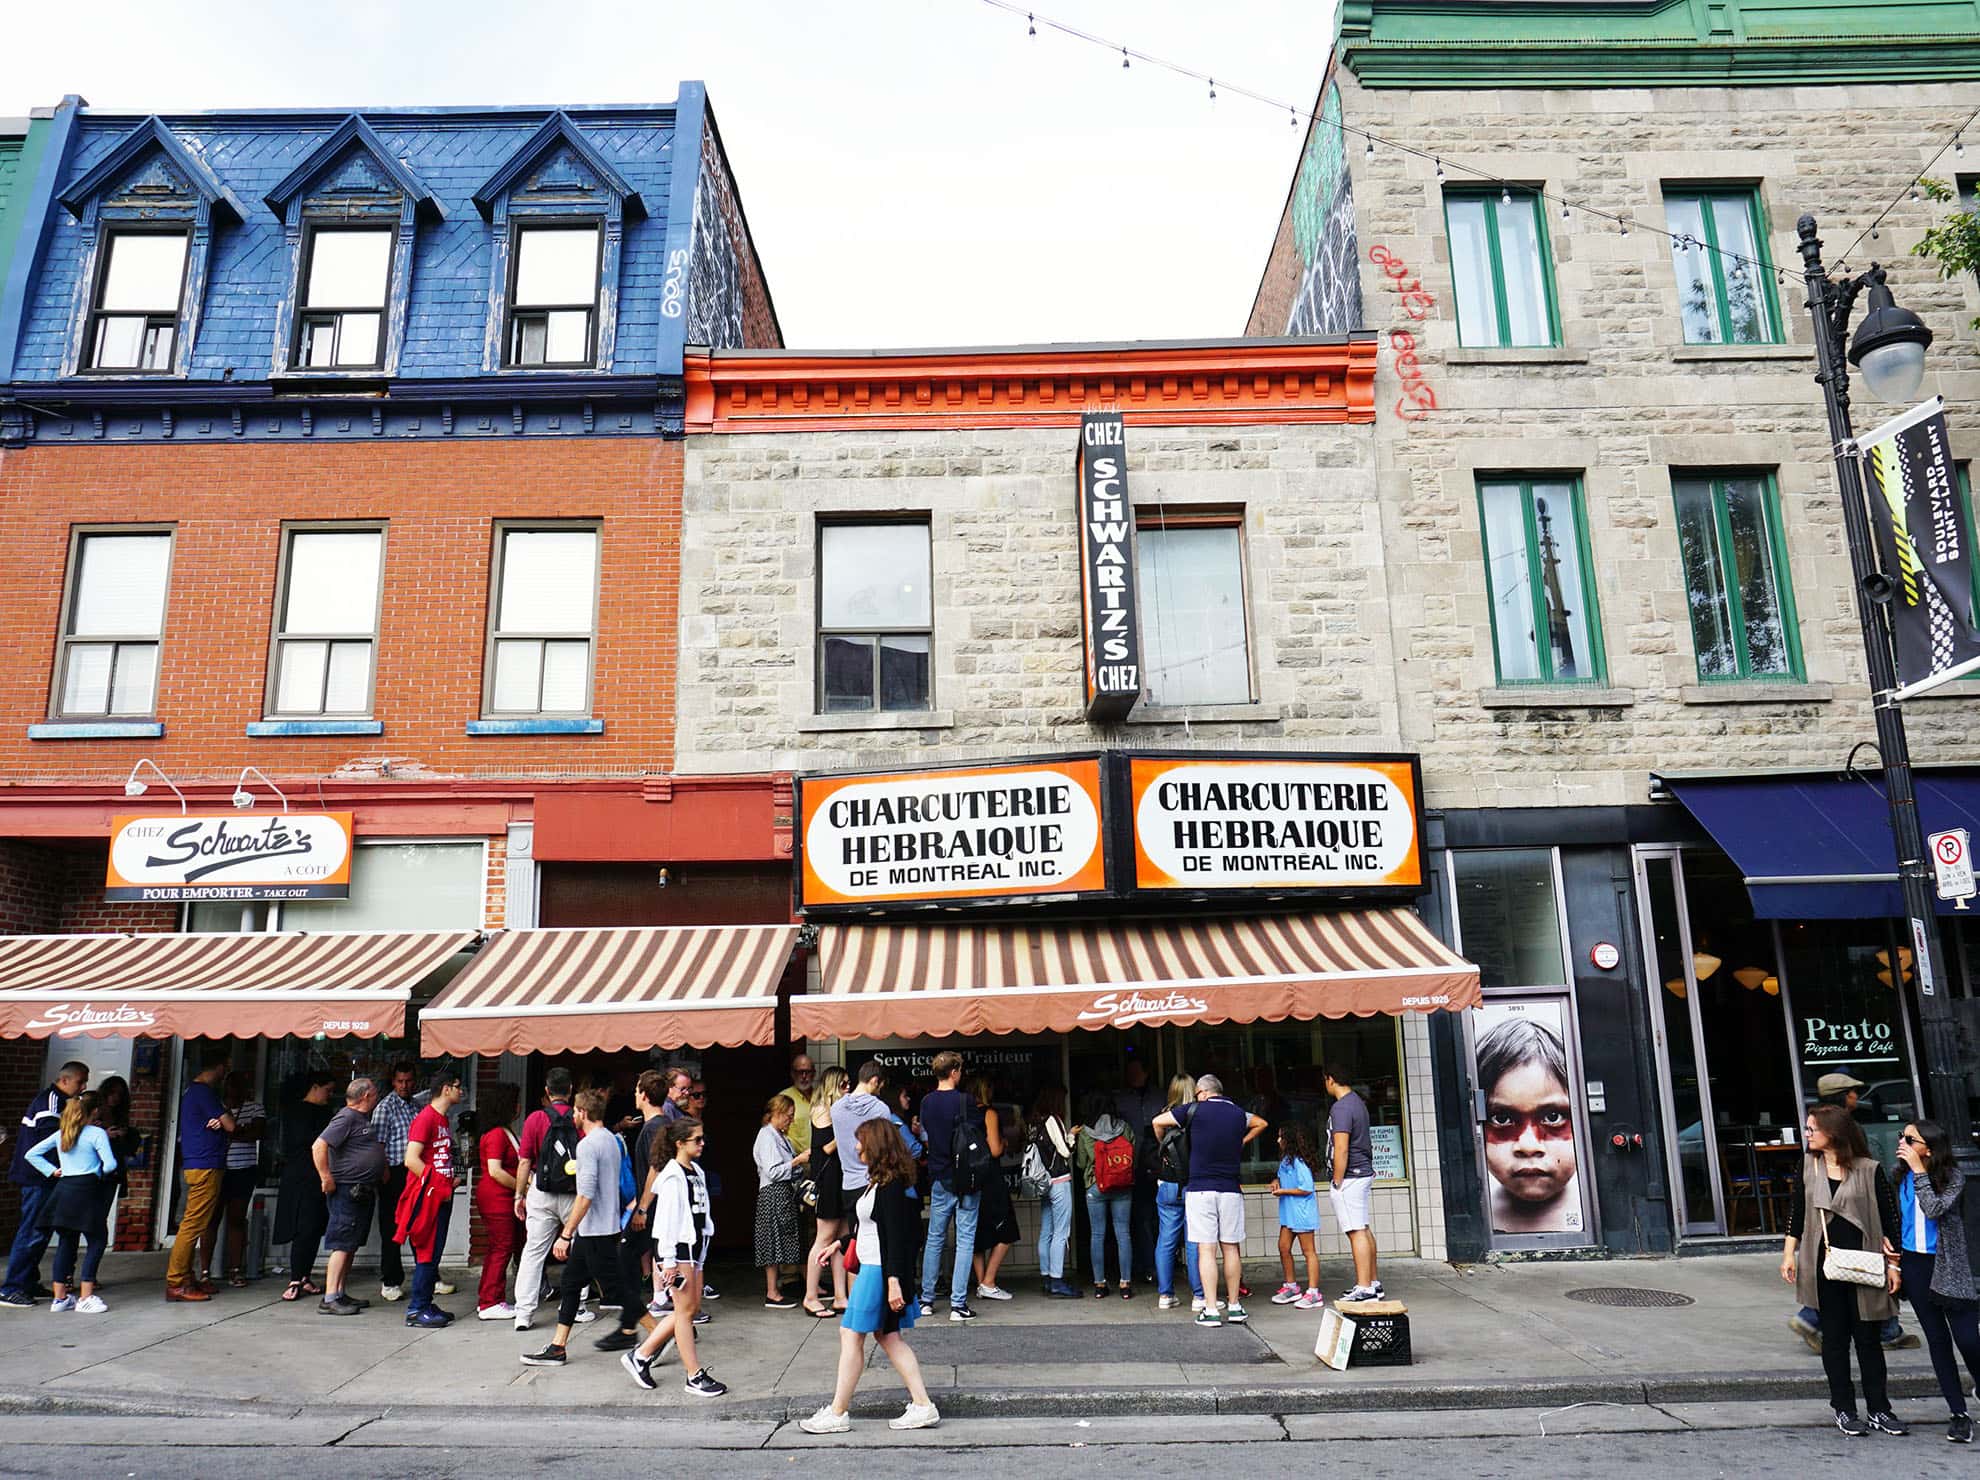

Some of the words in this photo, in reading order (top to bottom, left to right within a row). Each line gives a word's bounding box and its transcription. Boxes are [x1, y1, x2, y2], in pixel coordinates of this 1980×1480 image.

[1084, 422, 1123, 447] CHEZ
[1928, 425, 1960, 560] SAINT-LAURENT
[1927, 467, 1948, 564] BOULEVARD
[1089, 457, 1130, 661] SCHWARTZ'S
[1098, 665, 1138, 691] CHEZ
[829, 785, 1071, 829] CHARCUTERIE
[1158, 782, 1389, 812] CHARCUTERIE
[127, 826, 165, 839] CHEZ
[842, 824, 1063, 865] HEBRAIQUE
[1173, 820, 1383, 853] HEBRAIQUE
[146, 817, 313, 884] Schwartz's
[1183, 855, 1212, 872] DE
[1223, 853, 1338, 871] MONTRÉAL
[1346, 854, 1384, 870] INC.
[850, 870, 879, 886] DE
[889, 861, 1010, 885] MONTRÉAL
[1018, 860, 1063, 878] INC.
[142, 887, 180, 900] POUR
[182, 887, 253, 899] EMPORTER
[263, 888, 287, 898] TAKE
[288, 888, 309, 898] OUT
[1077, 991, 1209, 1025] Schwartz's
[1402, 996, 1431, 1006] DEPUIS
[24, 1003, 156, 1035] Schwartz's
[323, 1021, 351, 1030] DEPUIS
[1803, 1018, 1891, 1041] Prato
[1804, 1042, 1849, 1056] Pizzeria
[1854, 1041, 1864, 1052] &
[1868, 1040, 1894, 1054] Café
